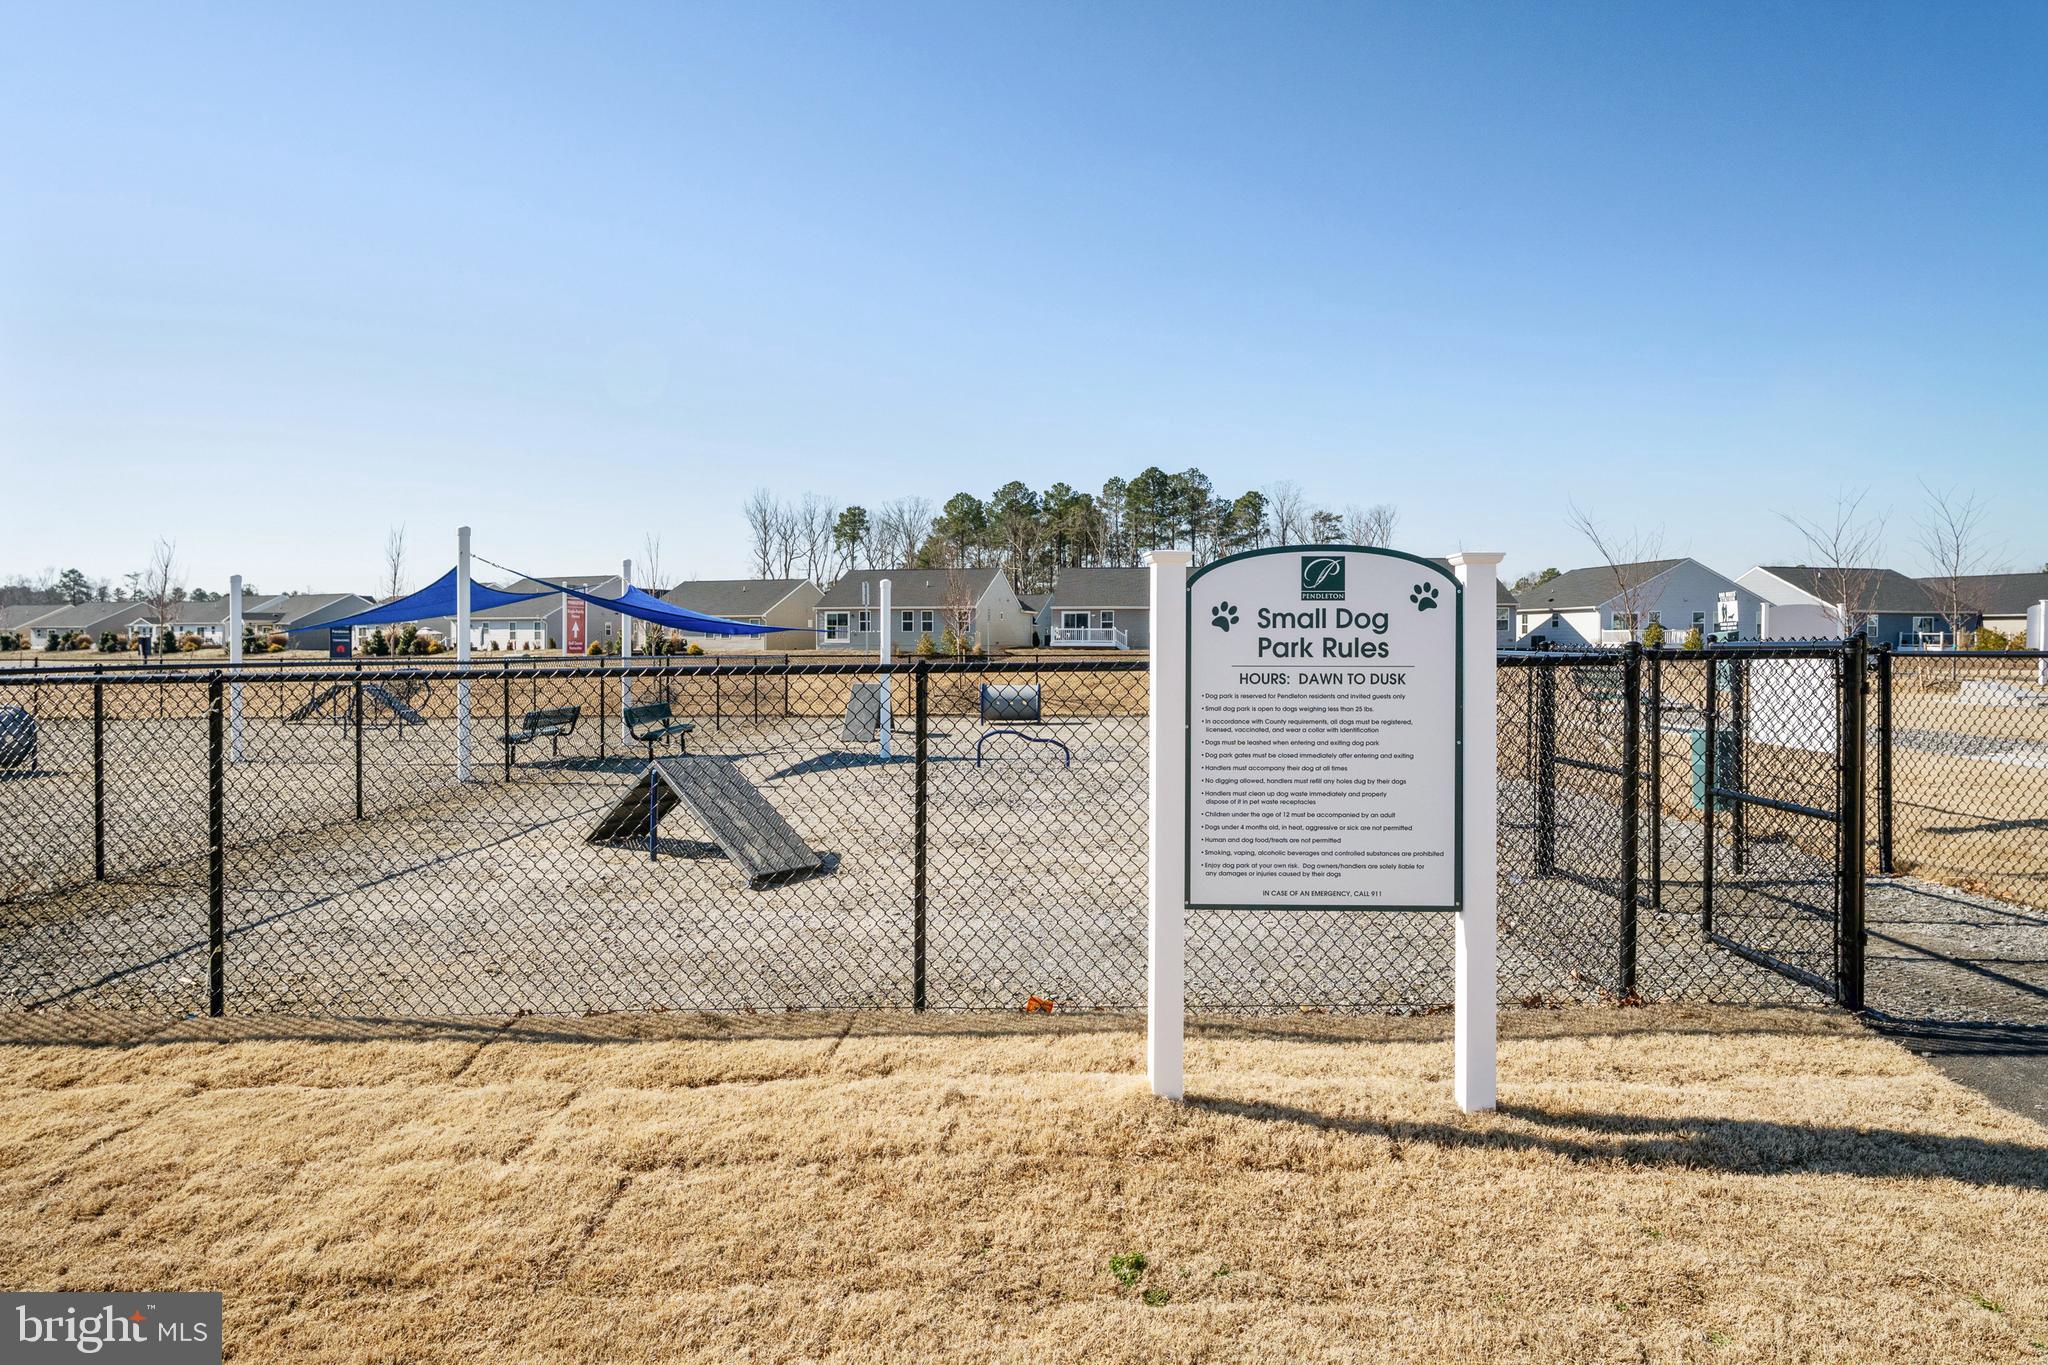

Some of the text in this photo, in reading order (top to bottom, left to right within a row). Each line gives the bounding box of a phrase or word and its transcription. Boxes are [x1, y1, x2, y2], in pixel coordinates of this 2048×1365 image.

[1257, 607, 1389, 634] Small Dog
[1258, 637, 1389, 658] Park Rules
[1239, 673, 1406, 685] HOURS: DAWN TO DUSK
[1330, 739, 1350, 747] exiting
[1352, 739, 1364, 747] dog
[1299, 752, 1337, 760] immediately
[1354, 752, 1379, 760] entering
[1394, 752, 1414, 760] exiting
[1306, 824, 1338, 832] aggressive
[1413, 850, 1444, 858] prohibited
[1205, 862, 1221, 870] Enjoy
